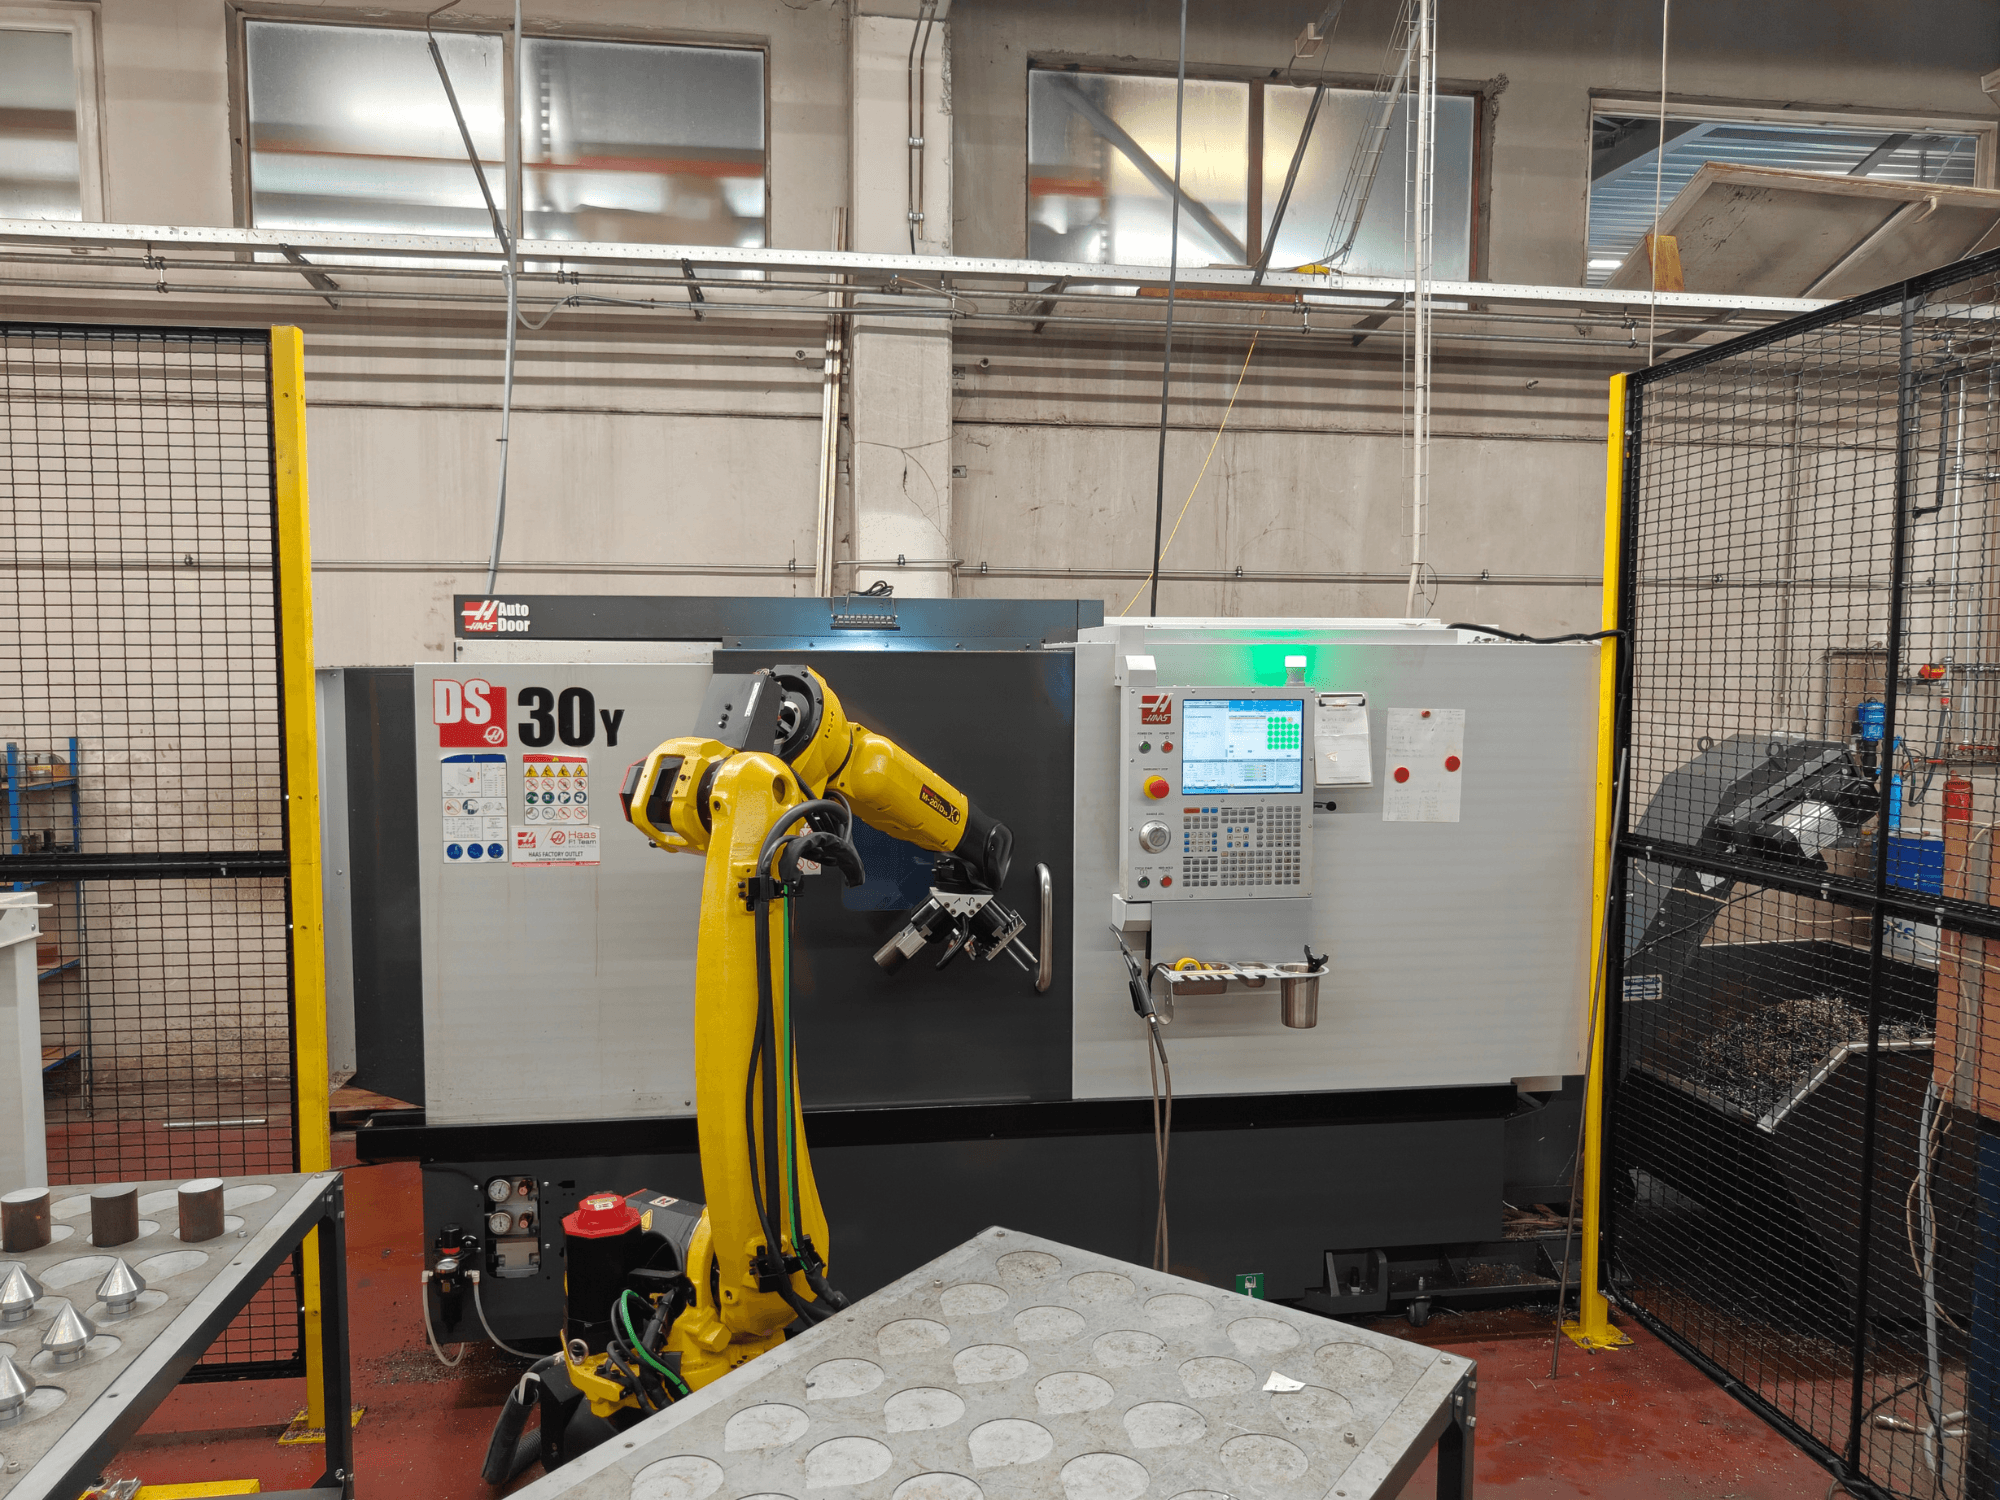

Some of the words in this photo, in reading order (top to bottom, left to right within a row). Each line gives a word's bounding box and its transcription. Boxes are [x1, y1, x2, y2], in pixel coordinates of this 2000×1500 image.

[497, 602, 530, 617] Auto
[465, 621, 498, 631] HAAS
[497, 617, 531, 632] Door
[433, 678, 492, 725] DS
[1142, 714, 1172, 722] HAAS
[568, 830, 597, 839] Haas
